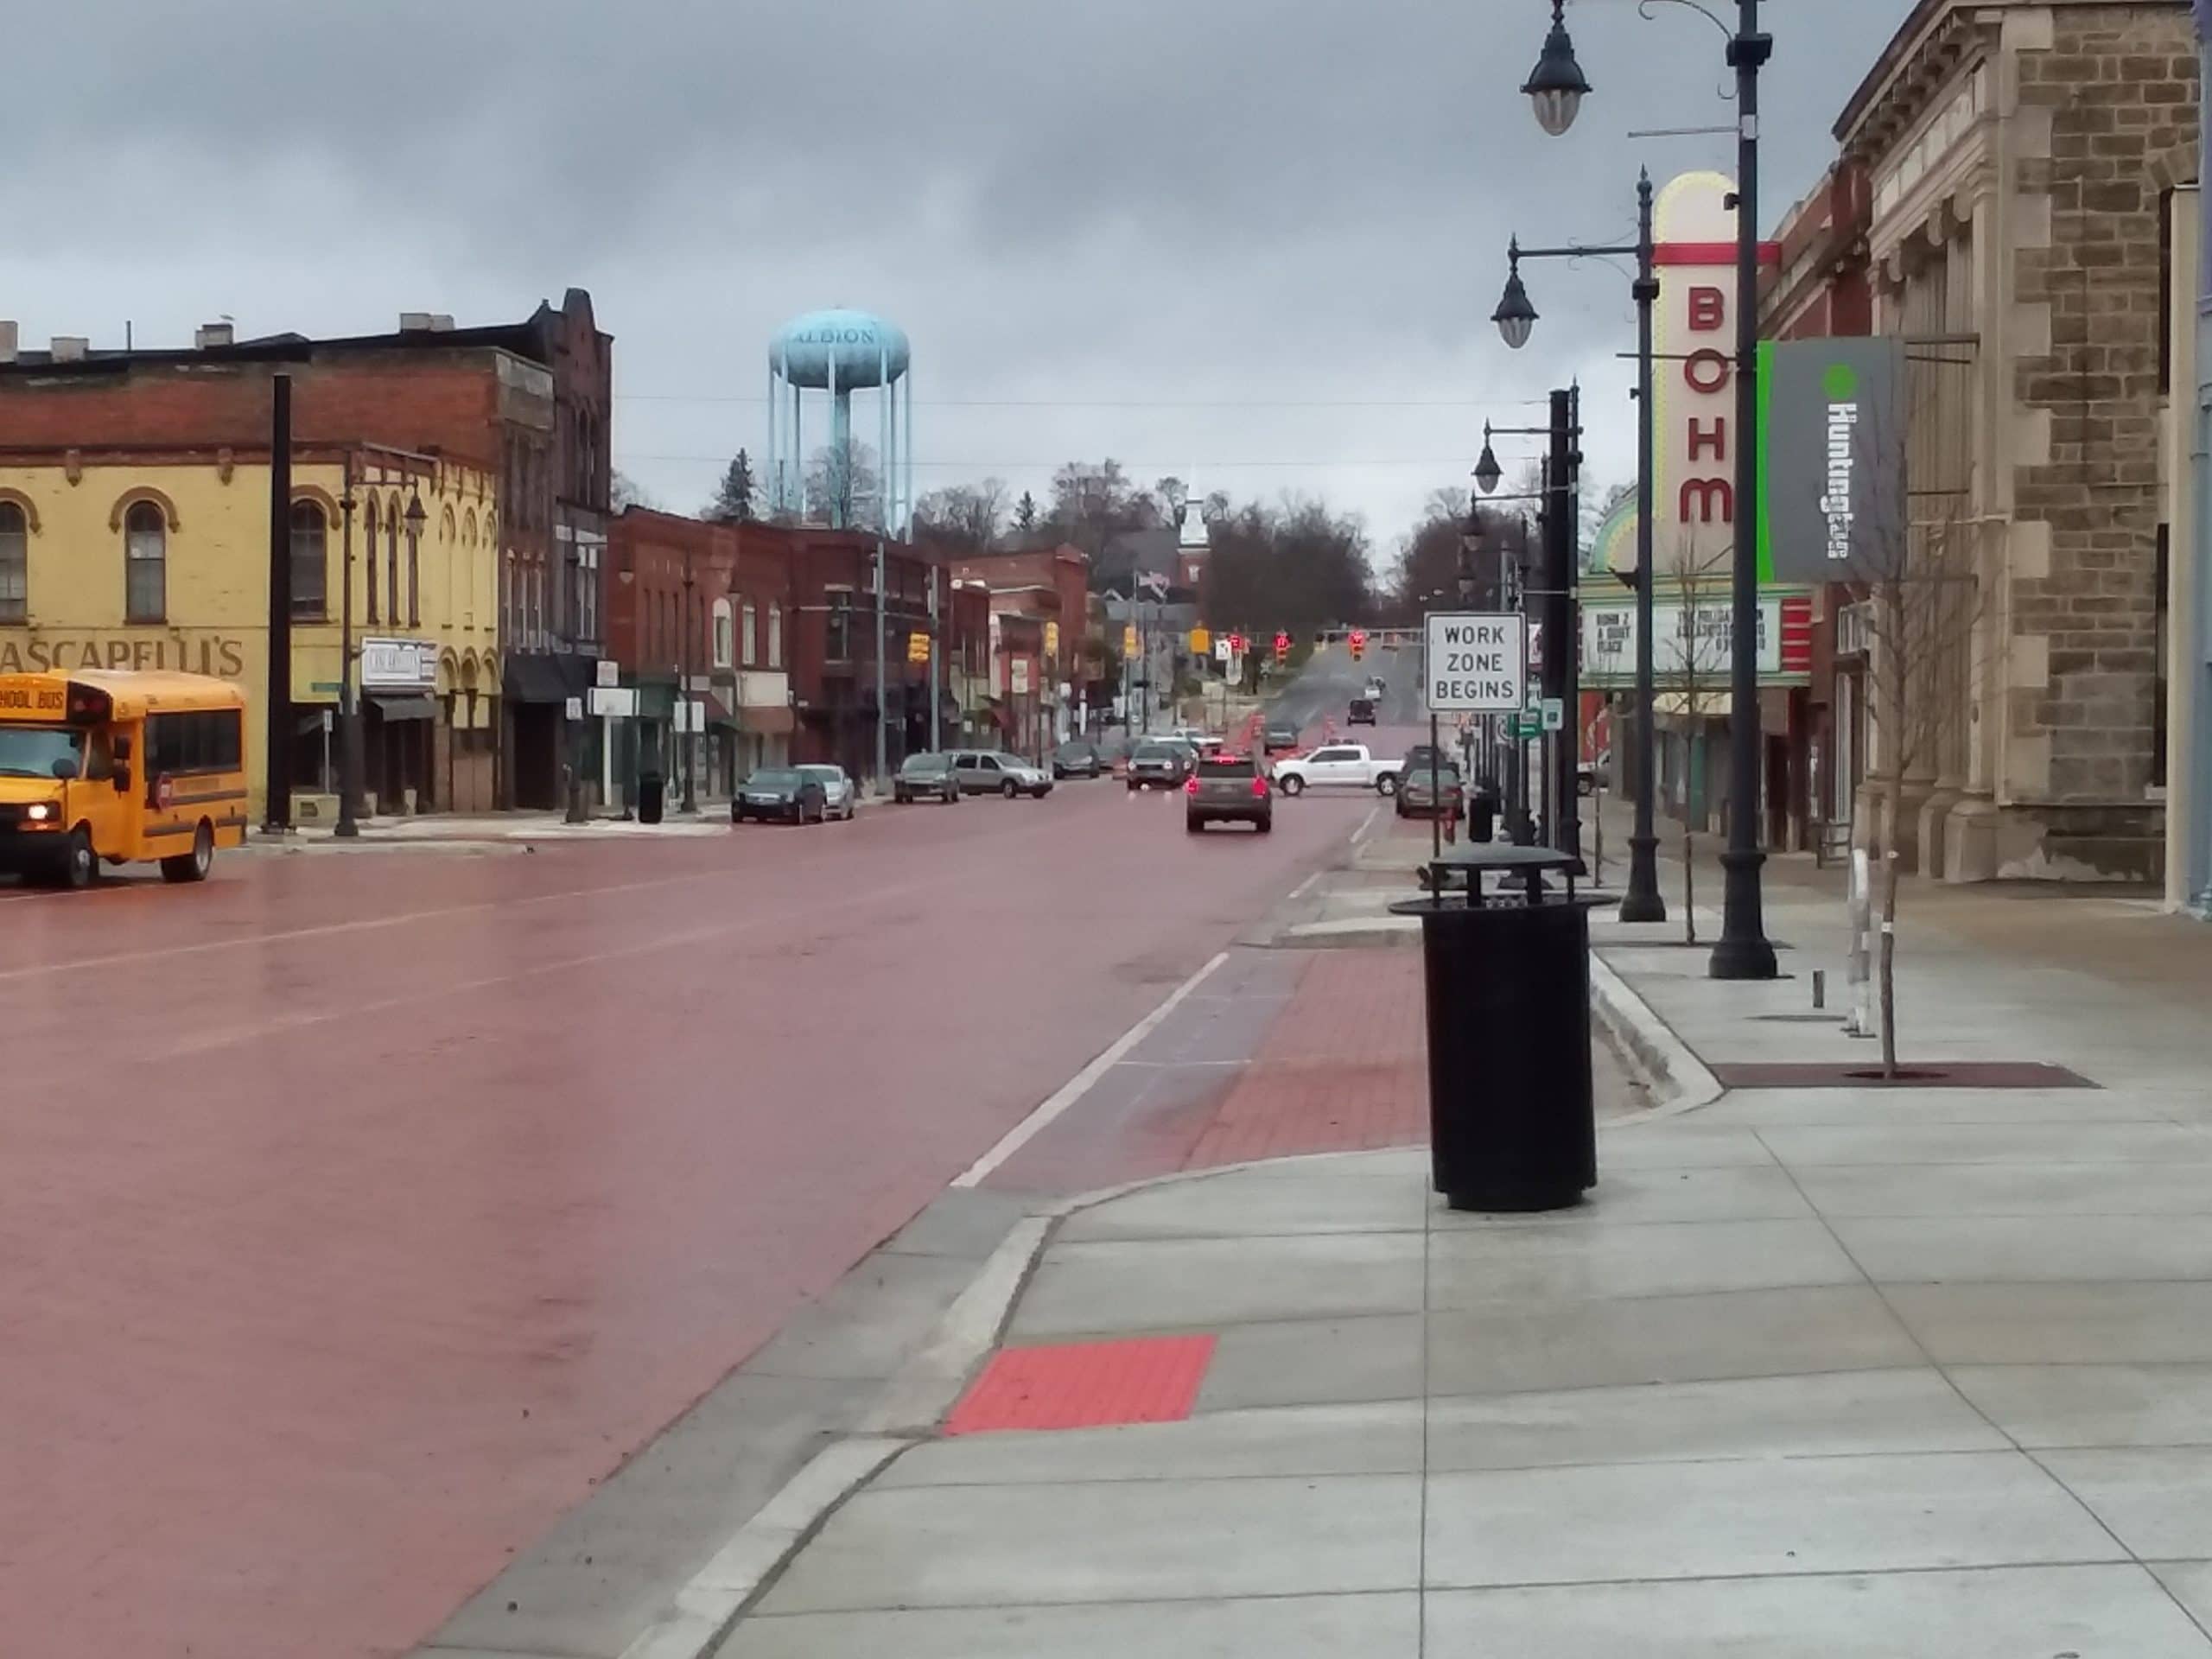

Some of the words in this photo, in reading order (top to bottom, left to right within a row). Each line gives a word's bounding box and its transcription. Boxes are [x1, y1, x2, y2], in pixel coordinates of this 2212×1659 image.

[793, 328, 874, 344] ALBION
[1680, 287, 1732, 523] BOHM
[1444, 626, 1504, 644] WORK
[1446, 653, 1503, 671] ZONE
[1435, 680, 1514, 699] BEGINS
[37, 690, 63, 709] BUS
